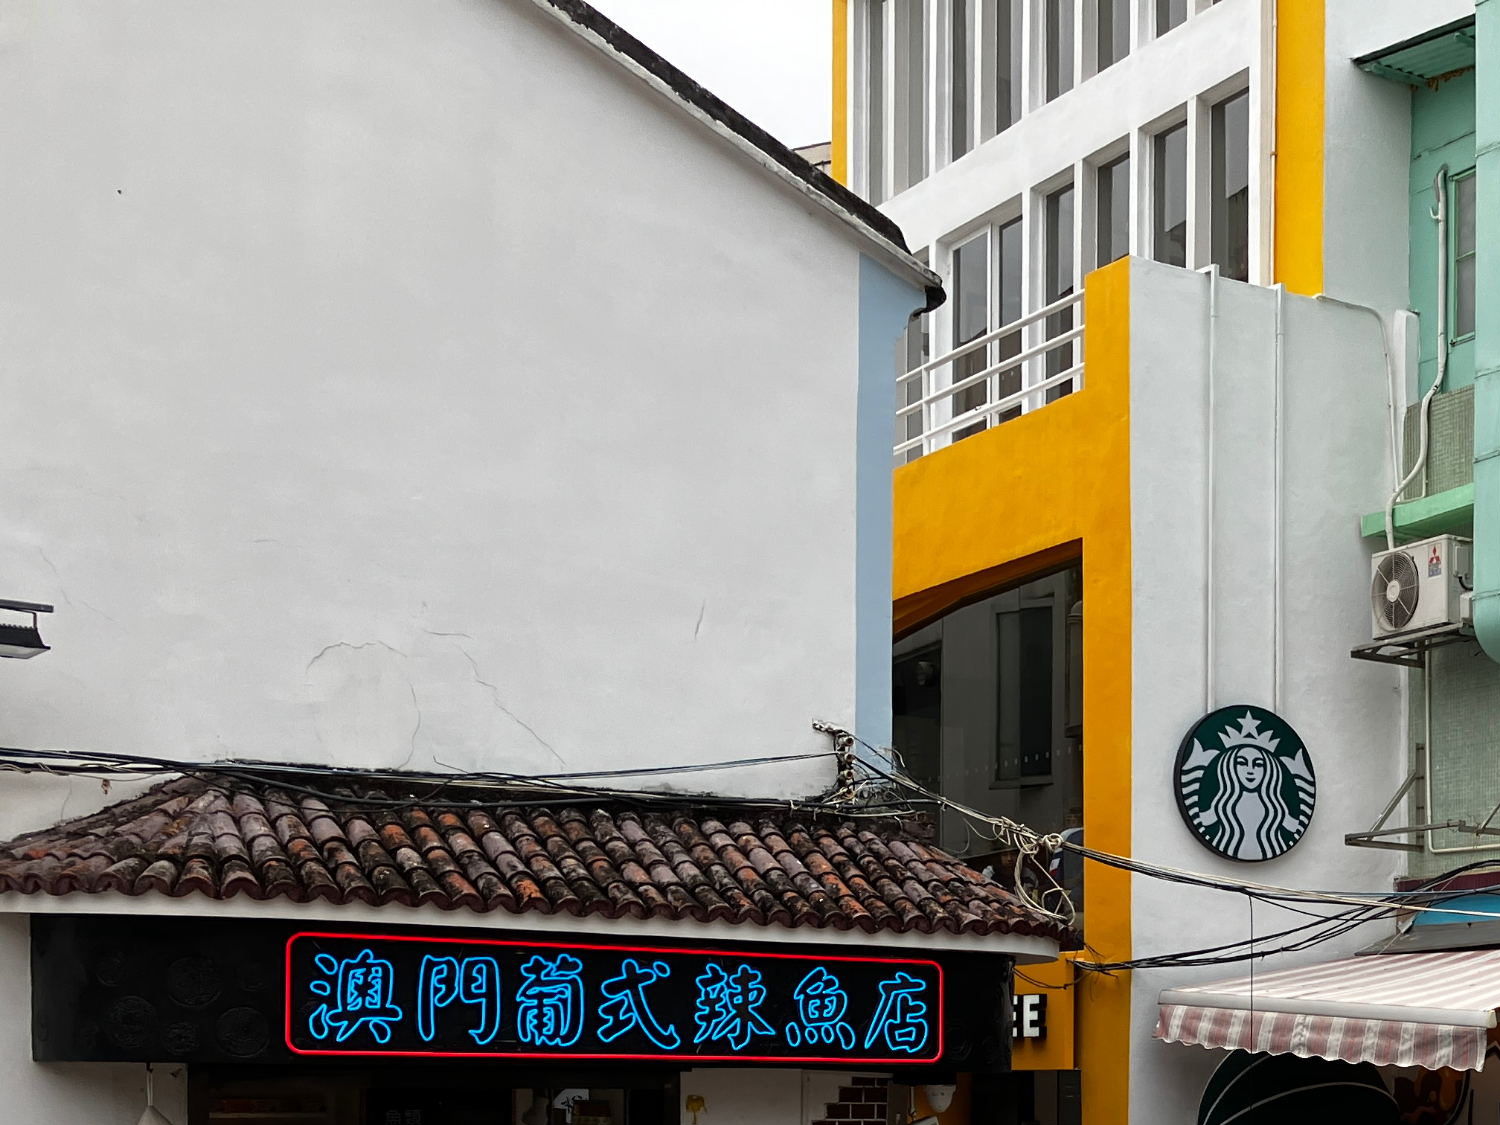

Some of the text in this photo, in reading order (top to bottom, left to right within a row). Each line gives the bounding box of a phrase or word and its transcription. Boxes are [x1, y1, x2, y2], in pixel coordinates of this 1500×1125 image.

[309, 948, 928, 1052] 澳門葡式辣魚店
